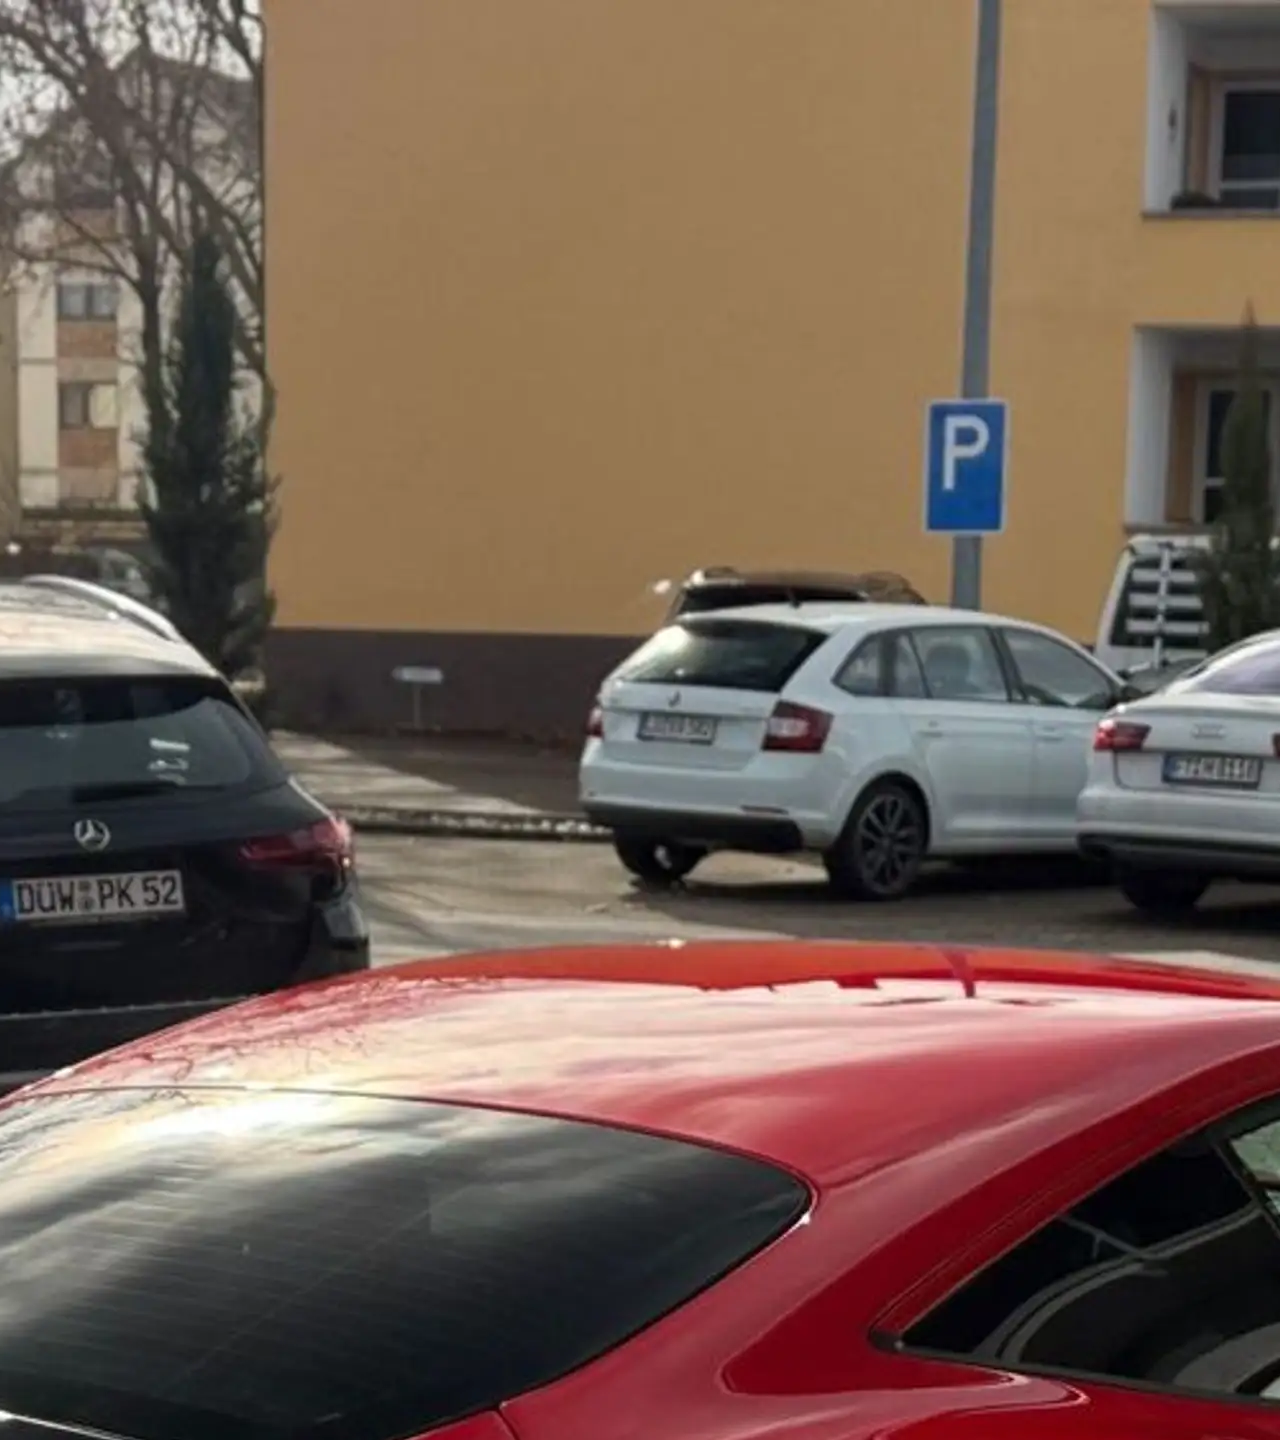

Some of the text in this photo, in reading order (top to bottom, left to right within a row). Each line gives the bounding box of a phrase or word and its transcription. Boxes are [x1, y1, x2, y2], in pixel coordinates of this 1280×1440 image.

[943, 414, 989, 491] P
[17, 874, 178, 914] DÜW PK 52
